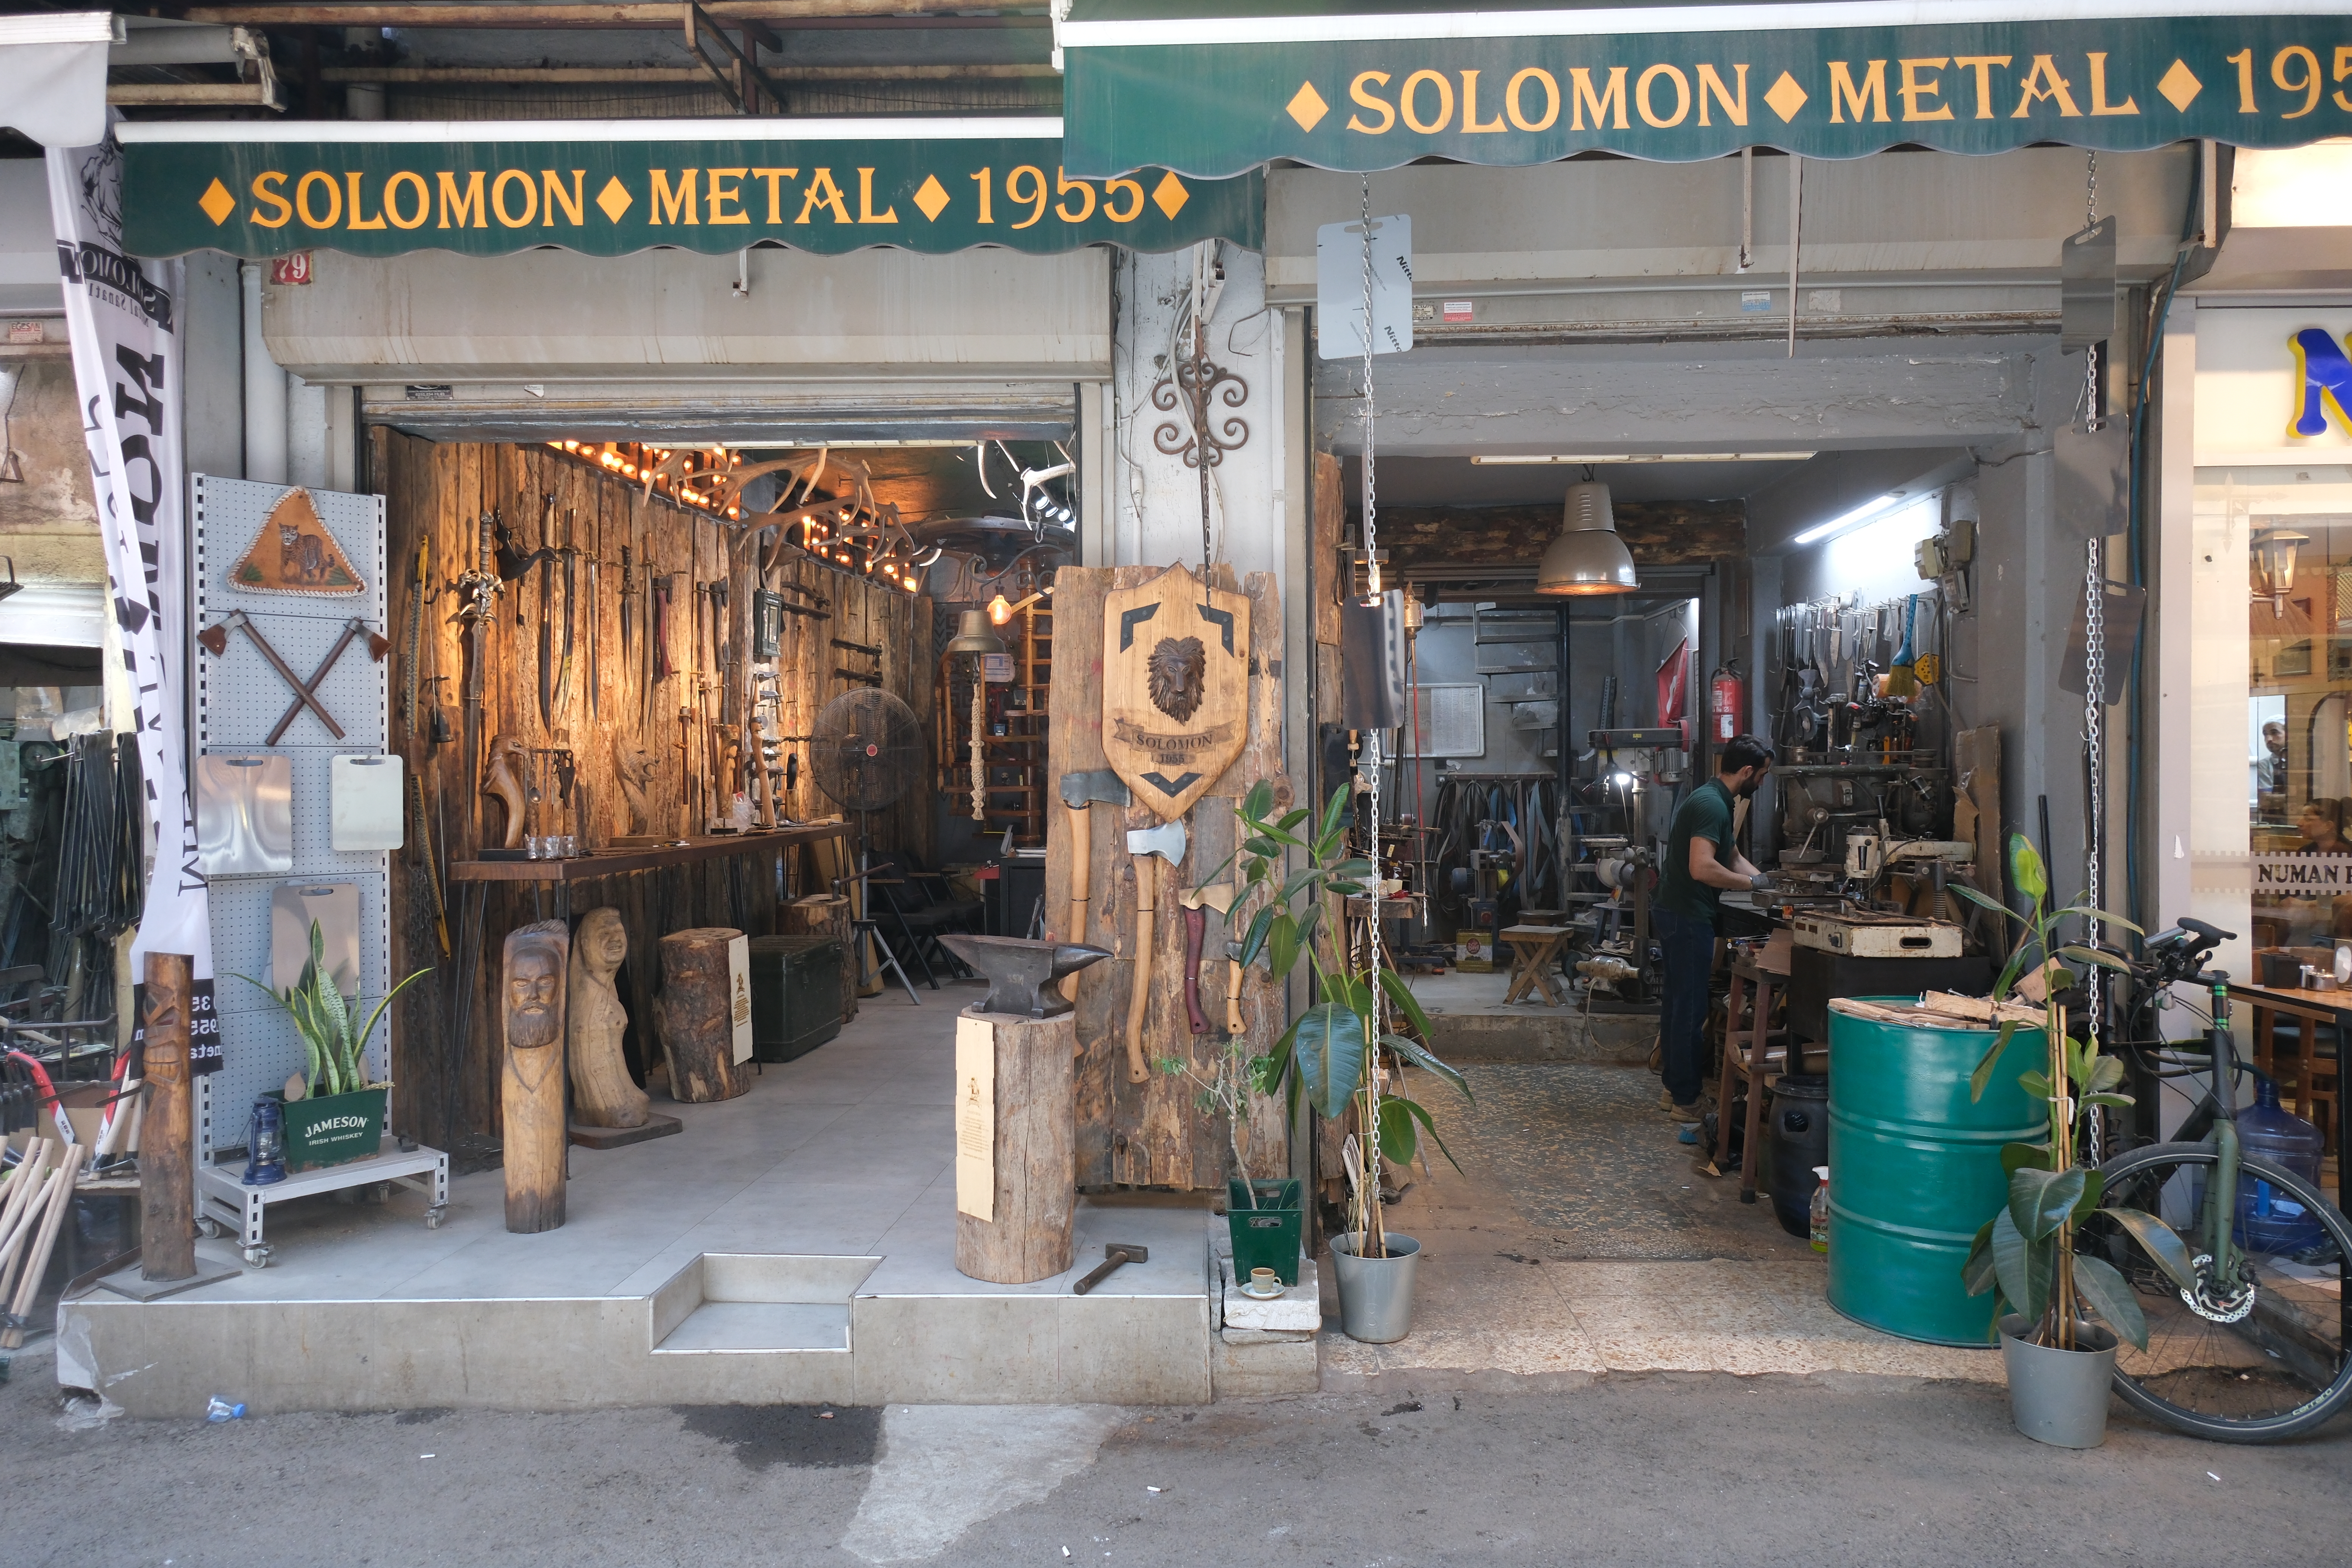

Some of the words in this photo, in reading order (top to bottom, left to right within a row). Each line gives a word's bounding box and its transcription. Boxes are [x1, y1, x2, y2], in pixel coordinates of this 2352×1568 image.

[1346, 64, 1750, 134] SOLOMON
[1827, 52, 2140, 123] METAL
[250, 170, 586, 230] SOLOMON
[649, 168, 899, 225] METAL
[970, 165, 1144, 229] 1955
[280, 254, 306, 279] 79
[1384, 325, 1402, 352] Nitto
[1137, 734, 1213, 750] SOLOMON
[1161, 754, 1184, 763] 1955
[2258, 864, 2339, 884] NUMAN
[305, 1116, 368, 1138] JAMESON
[331, 1132, 363, 1142] WHISKEY
[2292, 1387, 2332, 1415] carraro
